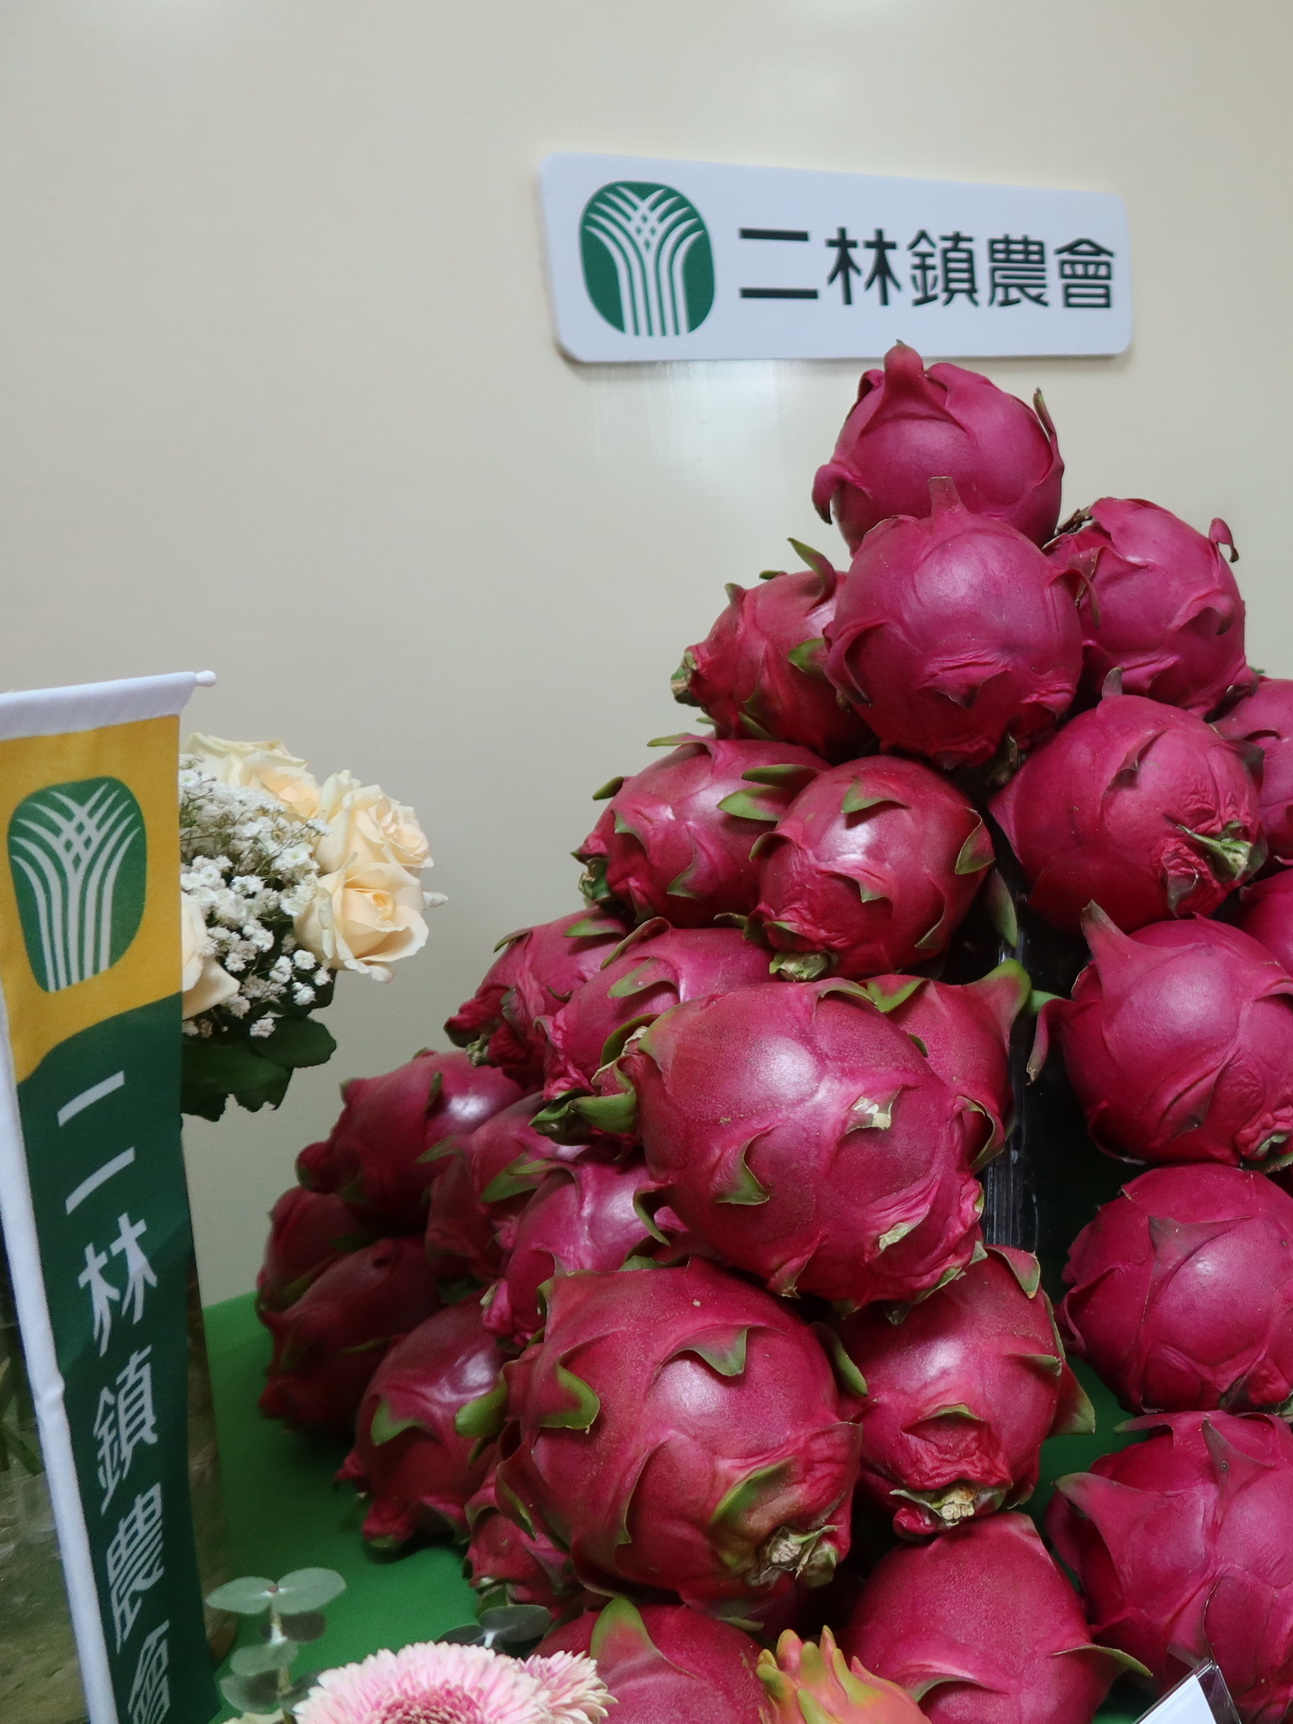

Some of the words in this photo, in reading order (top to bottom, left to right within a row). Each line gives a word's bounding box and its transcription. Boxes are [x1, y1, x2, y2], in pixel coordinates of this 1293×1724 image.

[738, 227, 1115, 309] 二林鎮農會
[57, 1070, 170, 1724] 二林鎮農會
